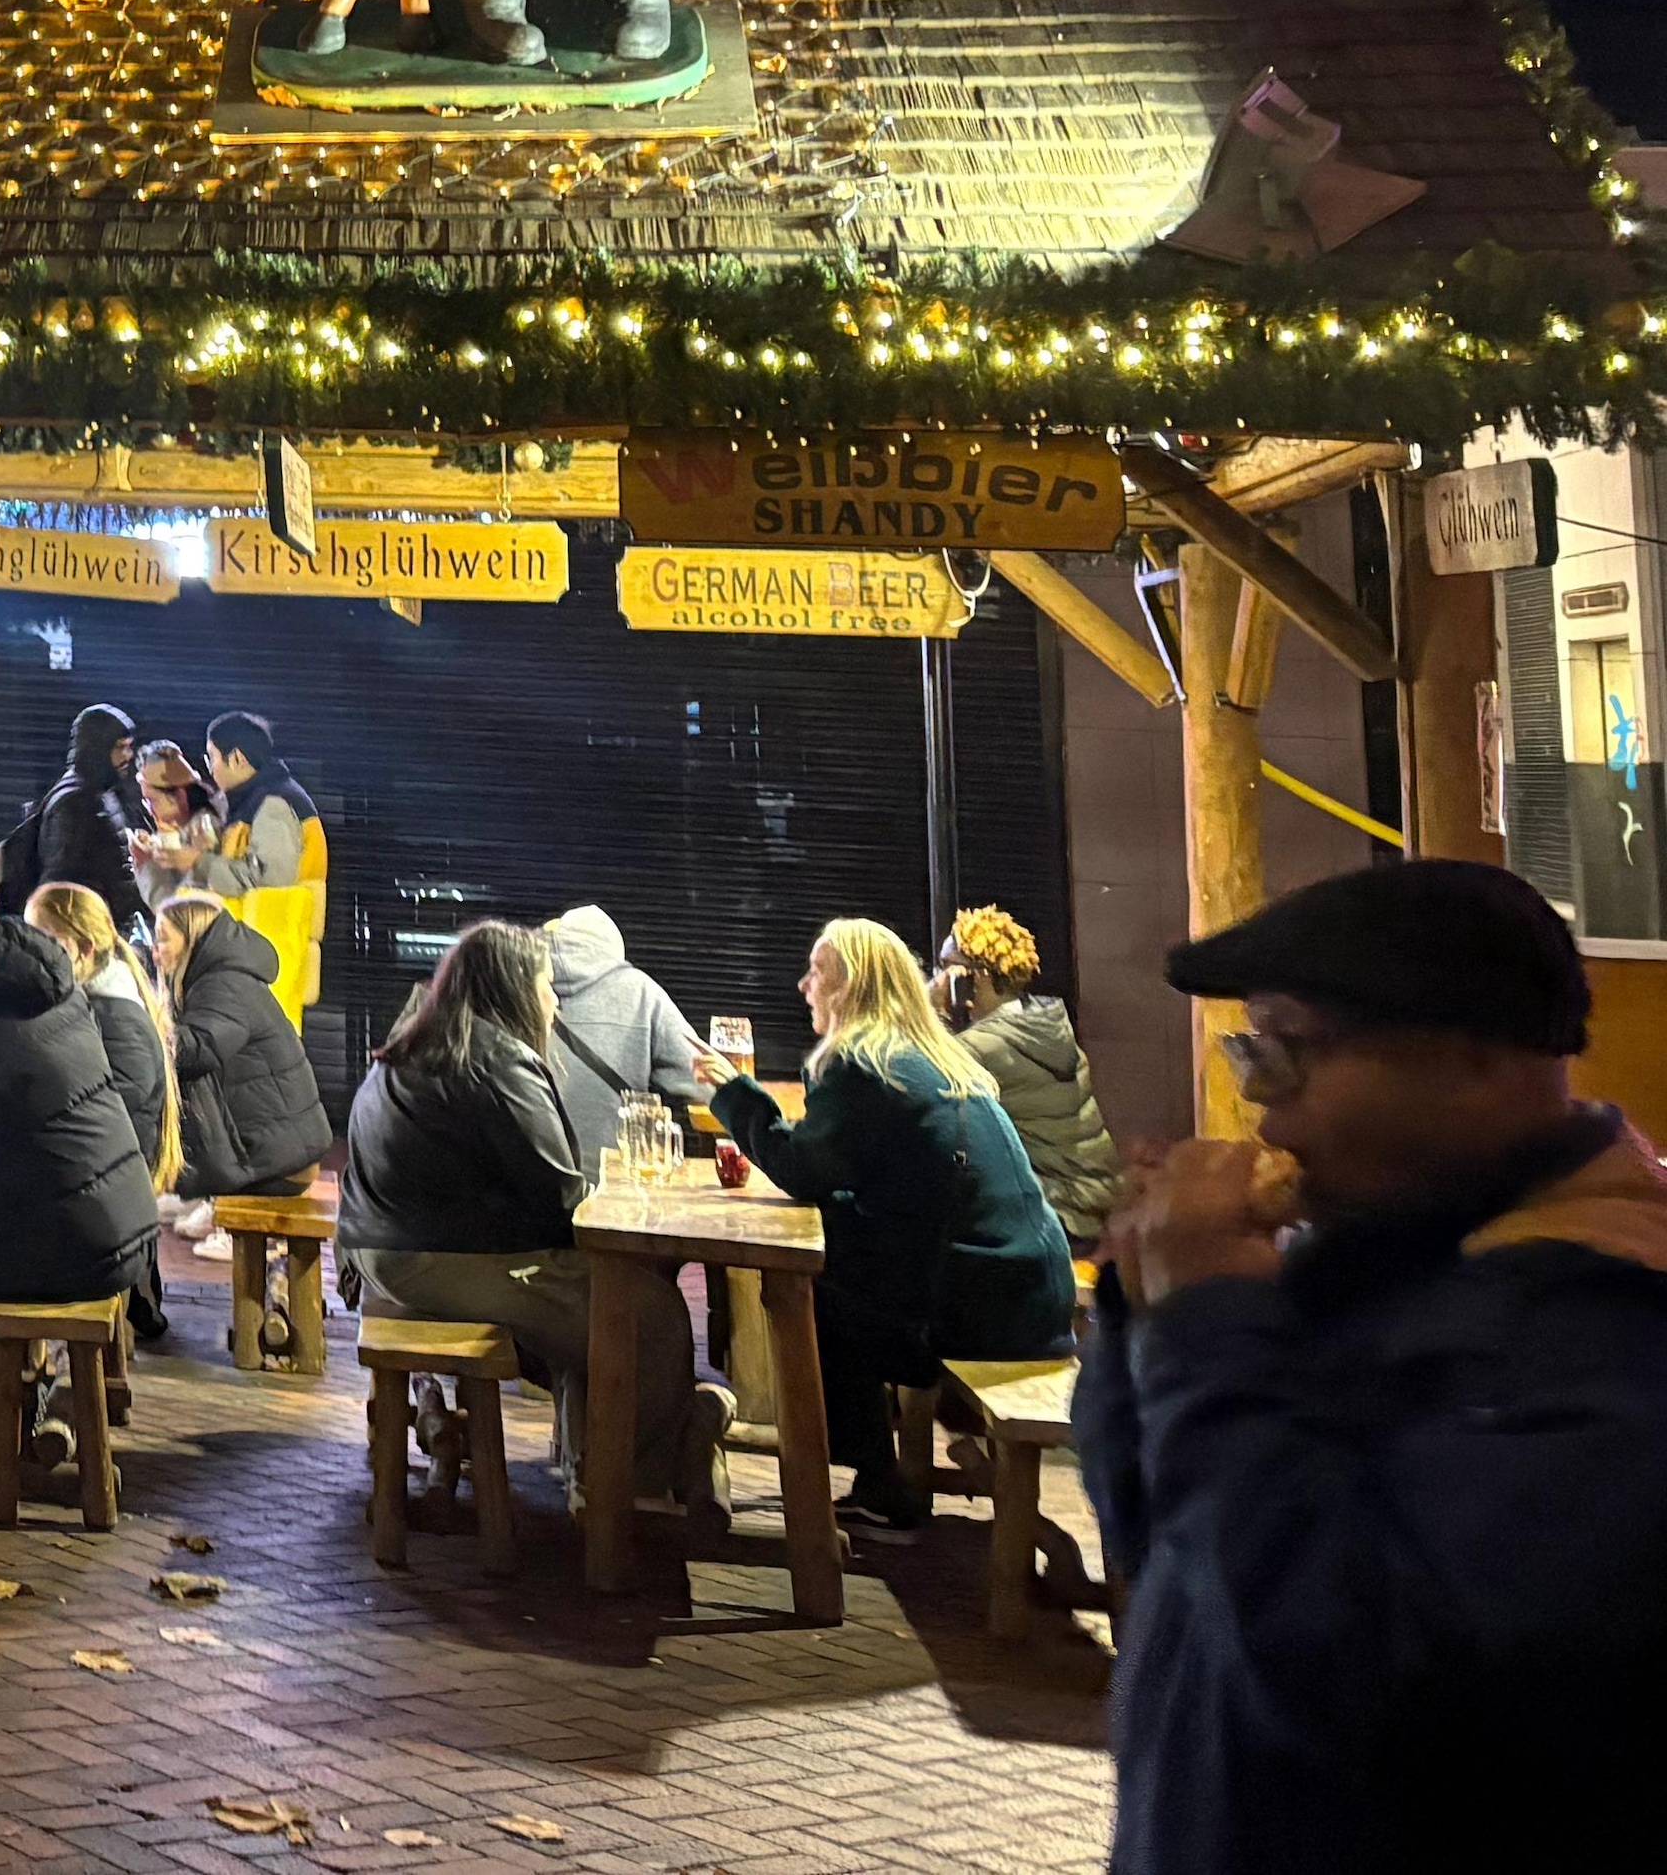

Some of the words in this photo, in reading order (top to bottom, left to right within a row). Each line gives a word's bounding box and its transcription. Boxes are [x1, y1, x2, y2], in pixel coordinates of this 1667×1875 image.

[639, 437, 1099, 513] Weißbier
[754, 498, 986, 540] SHANDY
[1438, 482, 1520, 559] Glühwein
[219, 528, 547, 588] Kirschglühwein
[651, 556, 814, 606] GERMAN
[827, 560, 929, 611] BEER
[671, 605, 812, 630] alcohol
[829, 608, 913, 632] free
